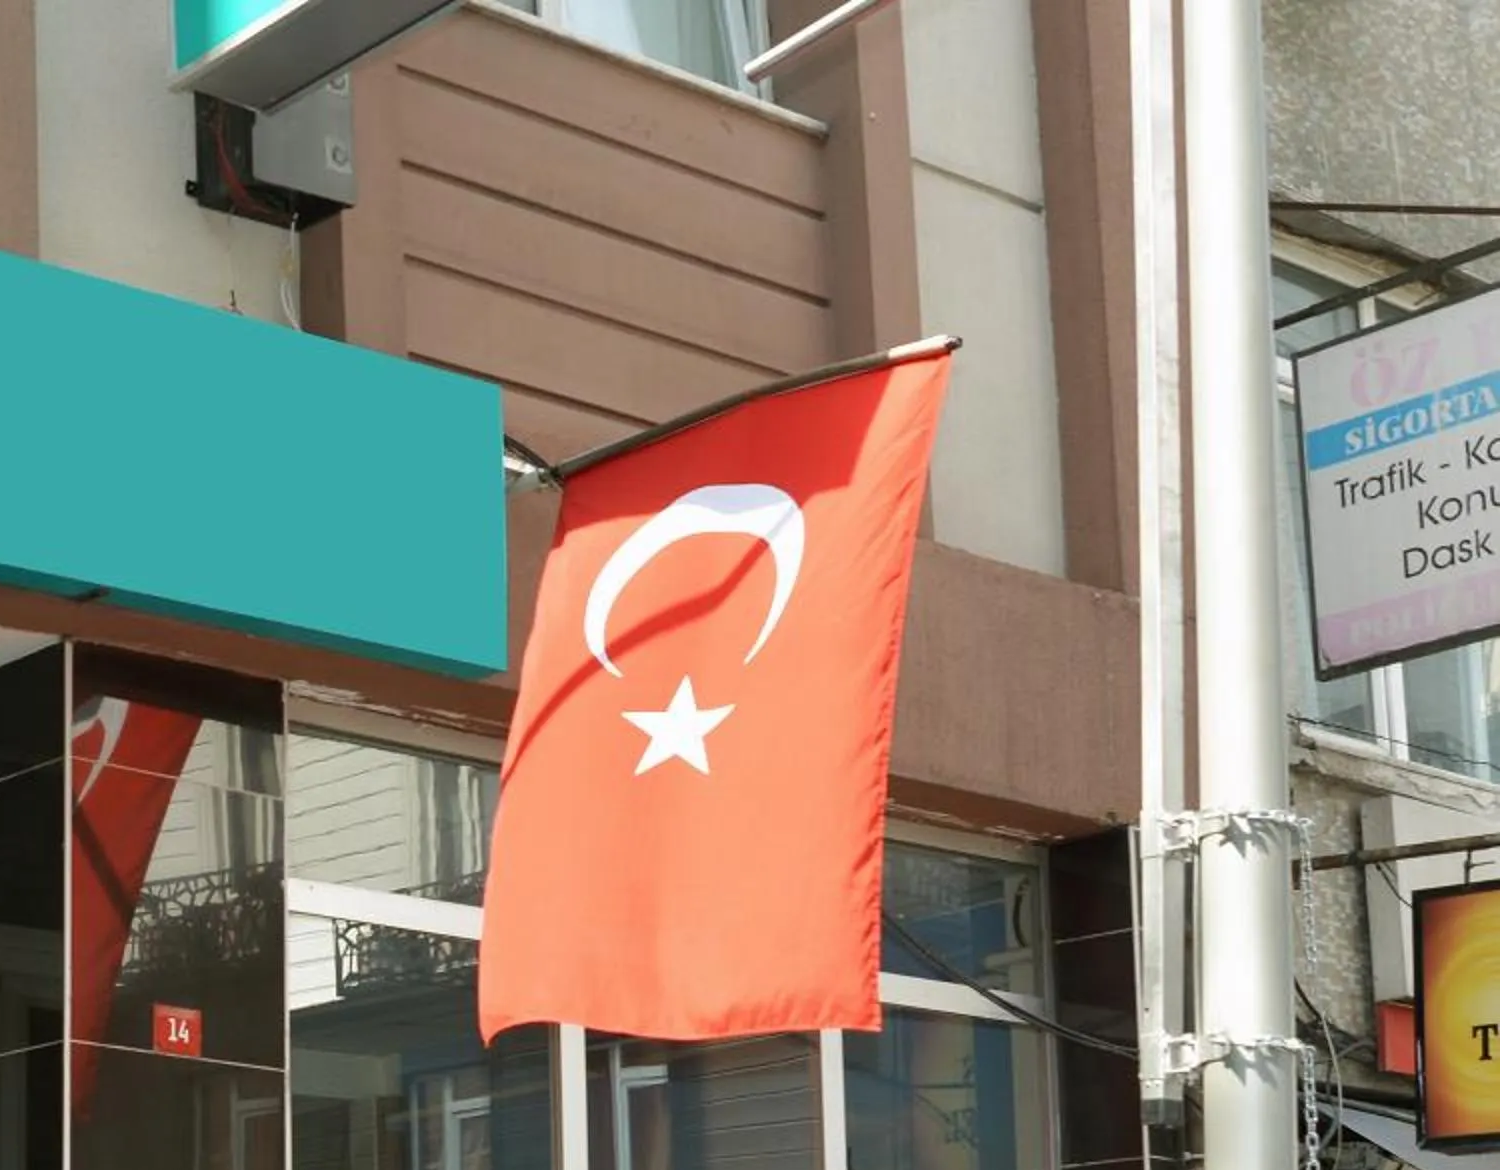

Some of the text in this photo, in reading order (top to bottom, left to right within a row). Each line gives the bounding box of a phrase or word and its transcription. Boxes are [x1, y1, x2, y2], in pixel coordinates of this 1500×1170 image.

[1351, 336, 1440, 408] ÖZ
[1334, 458, 1426, 508] Trafik
[1403, 529, 1495, 578] Dask
[167, 1017, 189, 1043] 14
